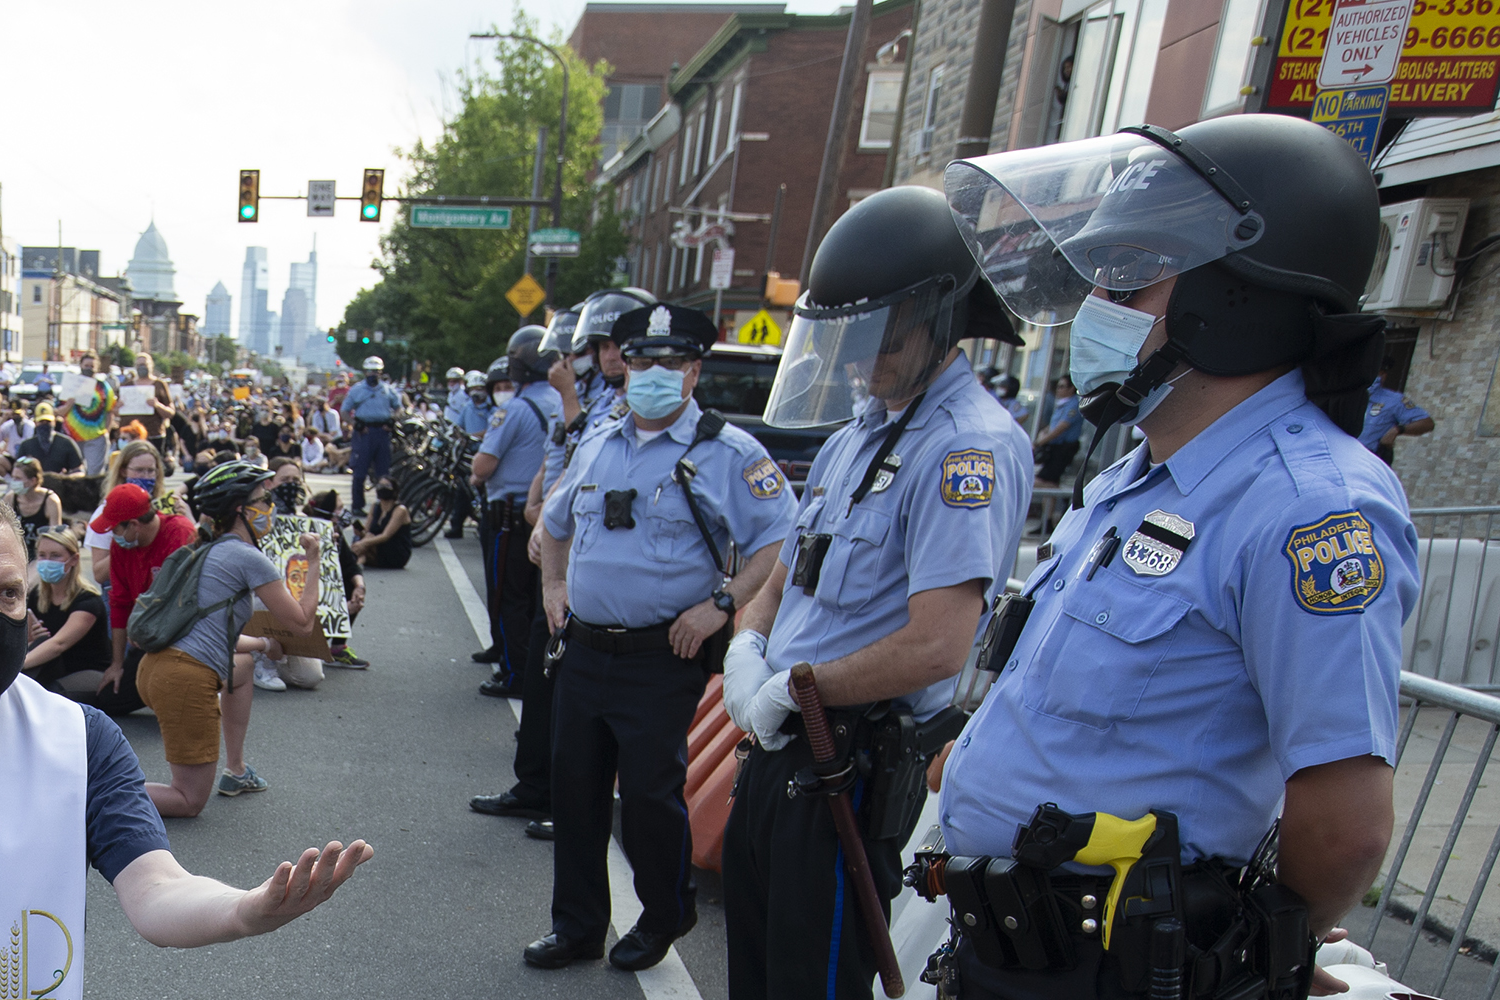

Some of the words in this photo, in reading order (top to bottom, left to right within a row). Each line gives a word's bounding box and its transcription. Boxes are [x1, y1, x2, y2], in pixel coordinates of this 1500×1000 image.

[1336, 6, 1406, 28] AUTHORIZED
[1336, 25, 1399, 45] VEHICLES
[1402, 26, 1500, 49] 9-6666
[1341, 45, 1383, 62] ONLY
[1389, 83, 1474, 101] ELIVERY
[1314, 94, 1340, 118] NO
[1341, 93, 1383, 112] PARKING
[417, 211, 486, 226] Montgomery
[490, 212, 505, 224] Av
[947, 461, 994, 482] POLICE
[1128, 541, 1172, 572] 3368
[1296, 529, 1374, 573] POLICE
